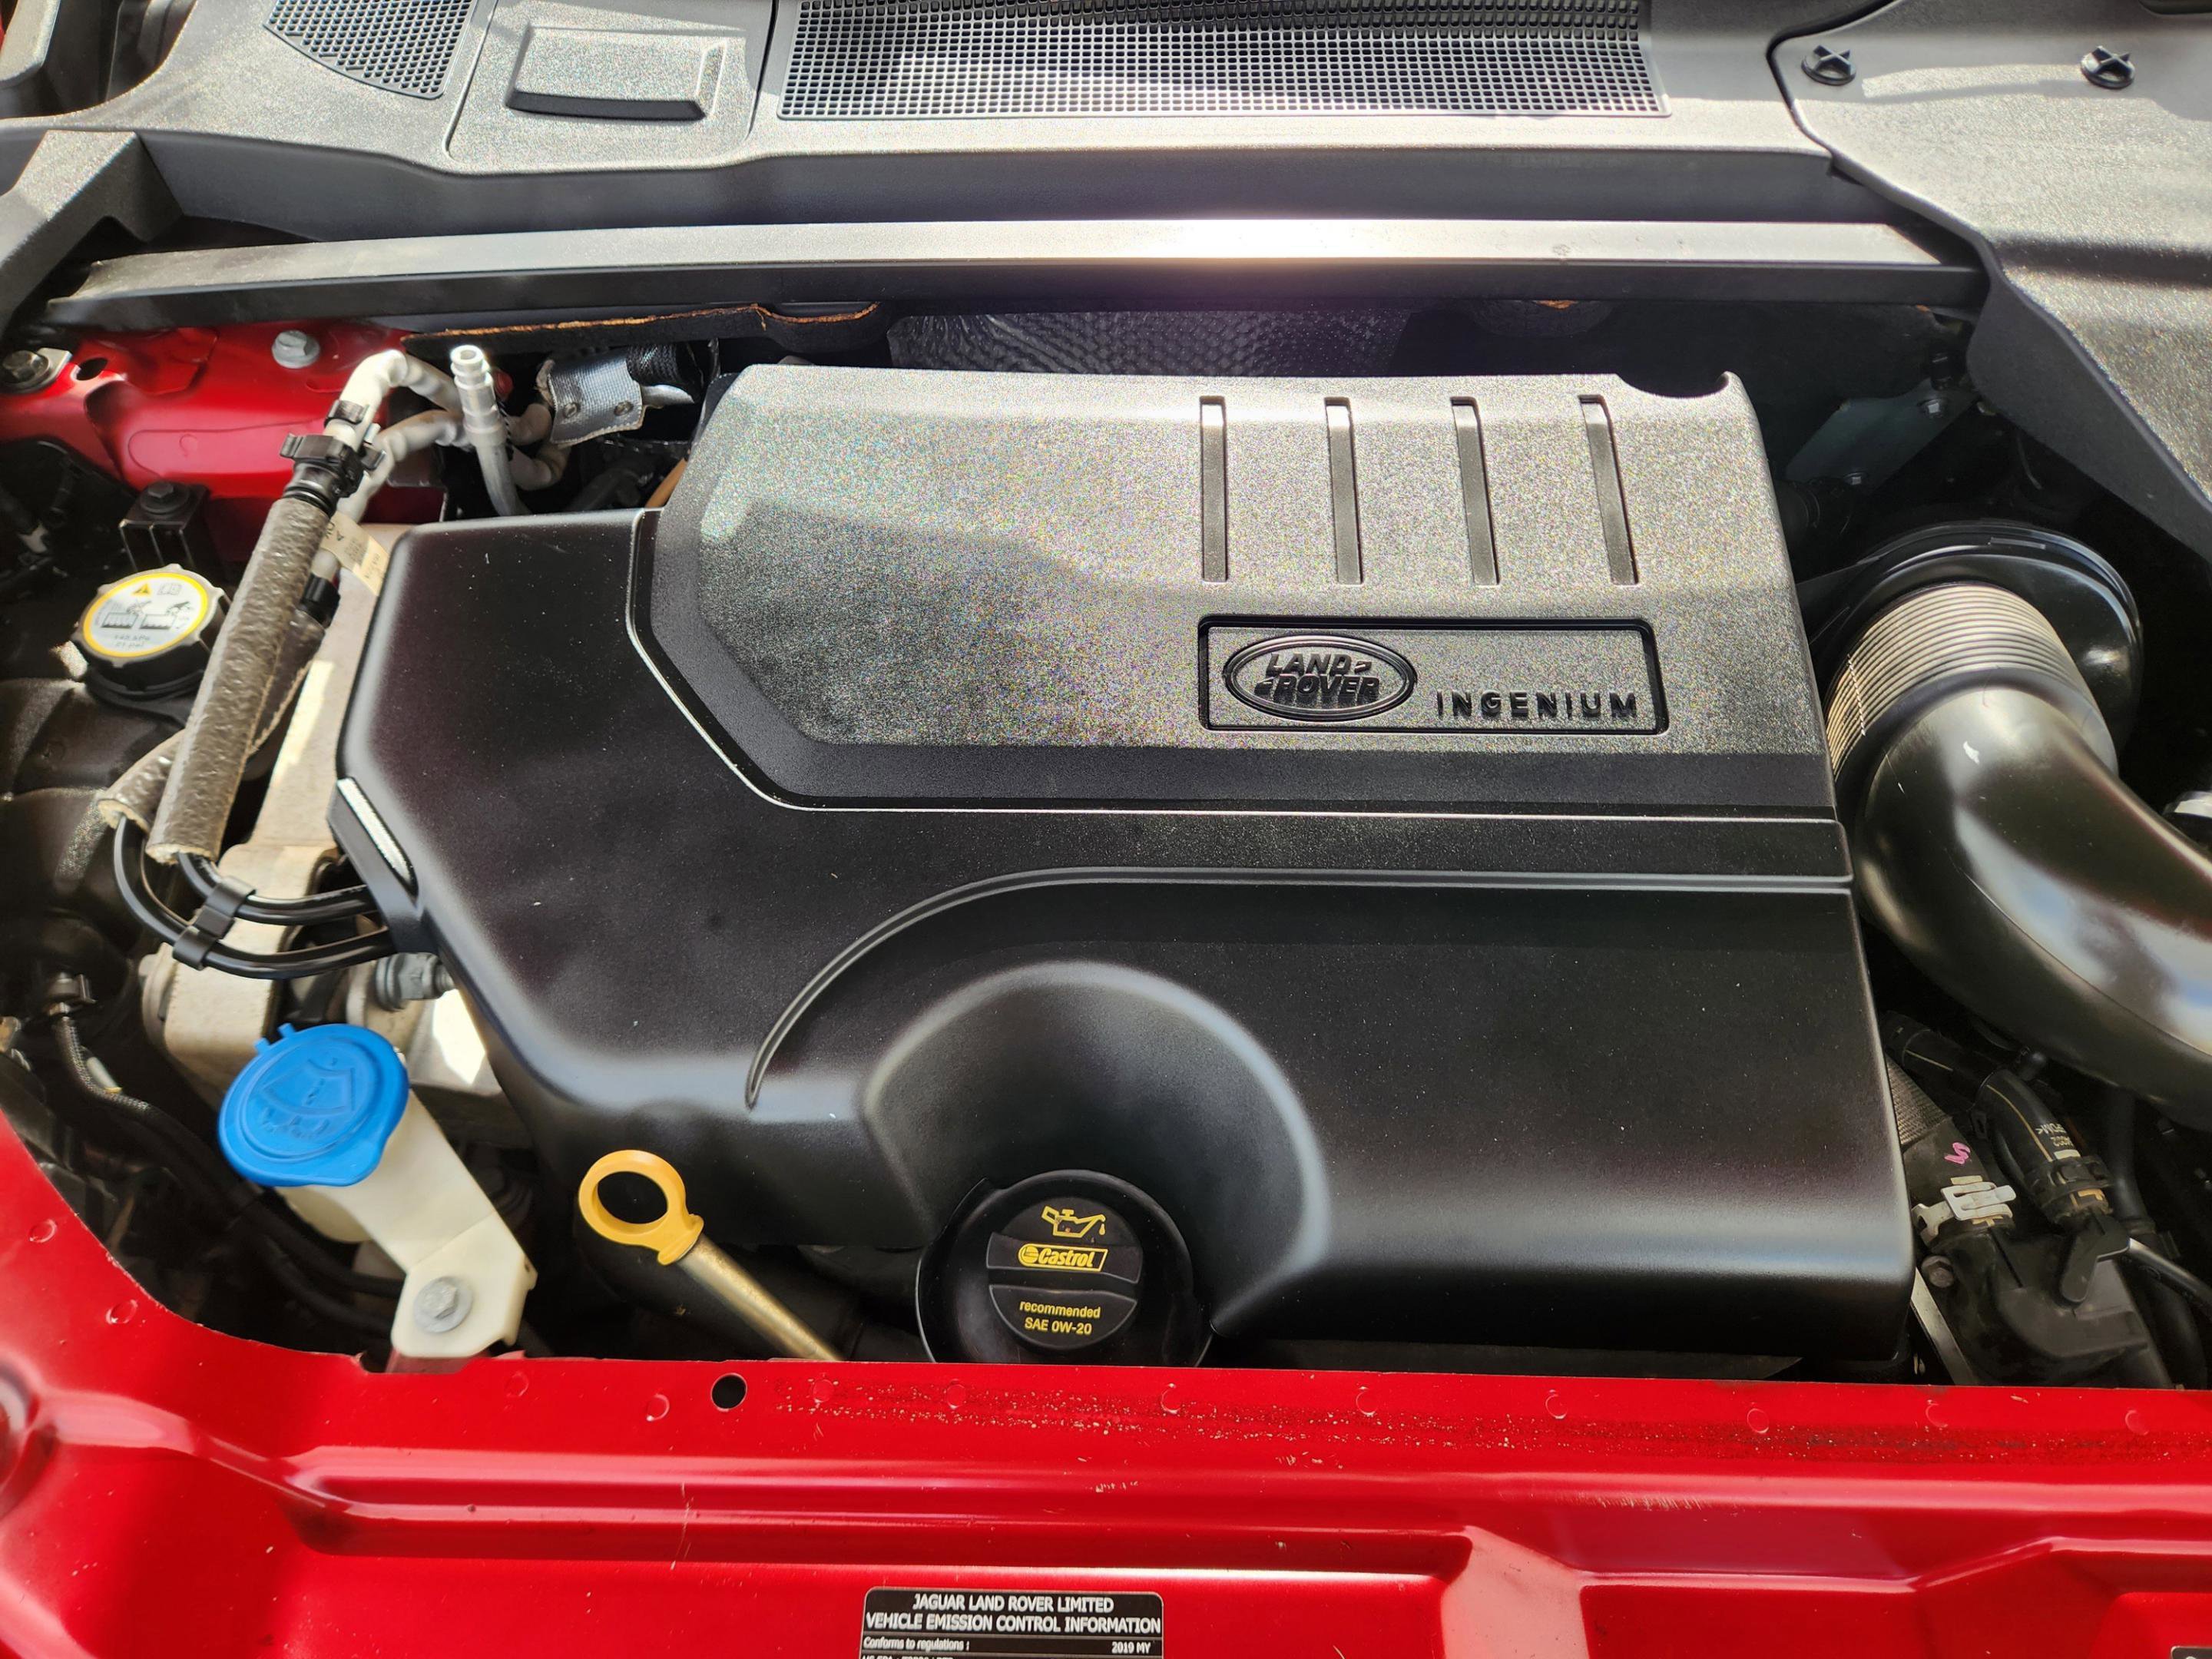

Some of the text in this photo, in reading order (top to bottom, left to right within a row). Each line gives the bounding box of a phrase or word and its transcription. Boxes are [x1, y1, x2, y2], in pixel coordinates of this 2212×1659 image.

[1266, 653, 1352, 676] LAND
[1273, 673, 1380, 702] ROVER
[1437, 690, 1637, 717] INGENIUM
[1038, 1247, 1095, 1267] Castrol
[1019, 1300, 1101, 1318] recommended
[1025, 1317, 1092, 1335] SAE 0W-20
[912, 1594, 1114, 1613] JAGUAR LAND ROVER LIMITED
[865, 1612, 1161, 1634] VEHICLE EMISSION CONTROL INFORMATION
[863, 1636, 905, 1649] Conforms
[906, 1637, 916, 1649] to
[917, 1637, 964, 1653] regulations
[1111, 1641, 1151, 1654] 2019 MY
